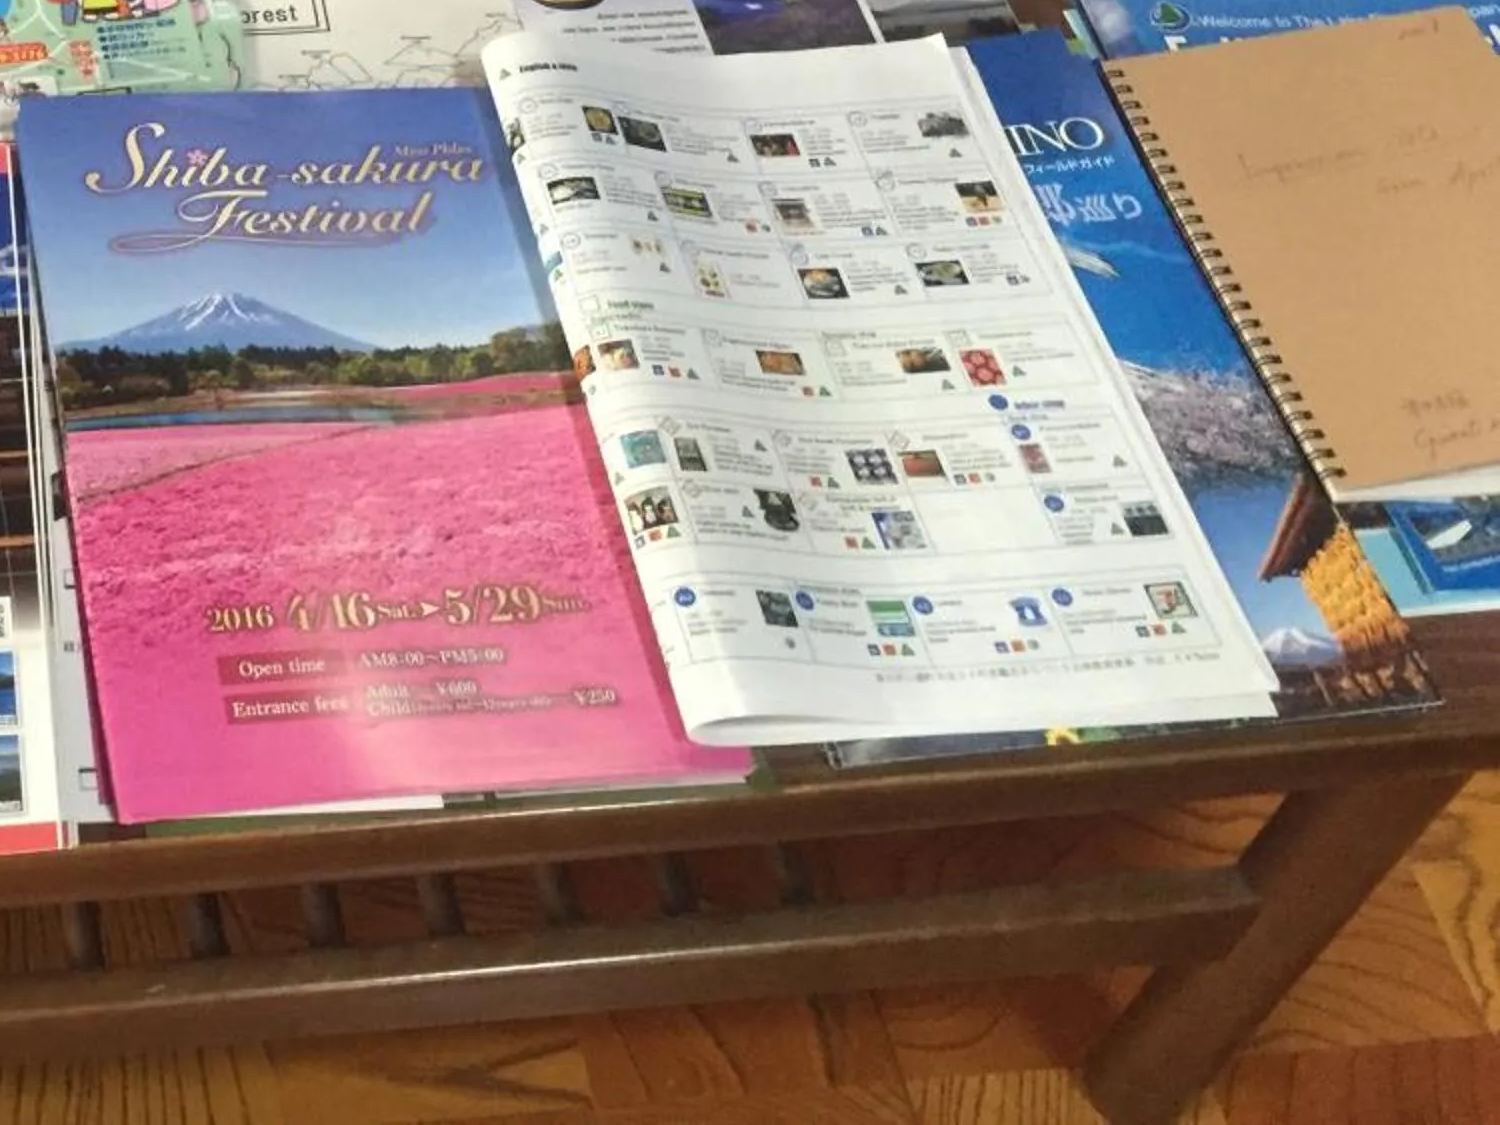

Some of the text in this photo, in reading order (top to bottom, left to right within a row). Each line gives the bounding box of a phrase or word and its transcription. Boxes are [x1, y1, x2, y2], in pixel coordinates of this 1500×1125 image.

[1198, 15, 1271, 28] Welcome
[85, 121, 484, 193] Shiba-sakura
[177, 189, 434, 238] Festival
[208, 603, 276, 633] 2016
[286, 591, 376, 632] 4/16
[443, 585, 540, 626] 5/29
[239, 660, 284, 680] Open
[288, 658, 326, 674] time
[232, 700, 310, 719] Entrance
